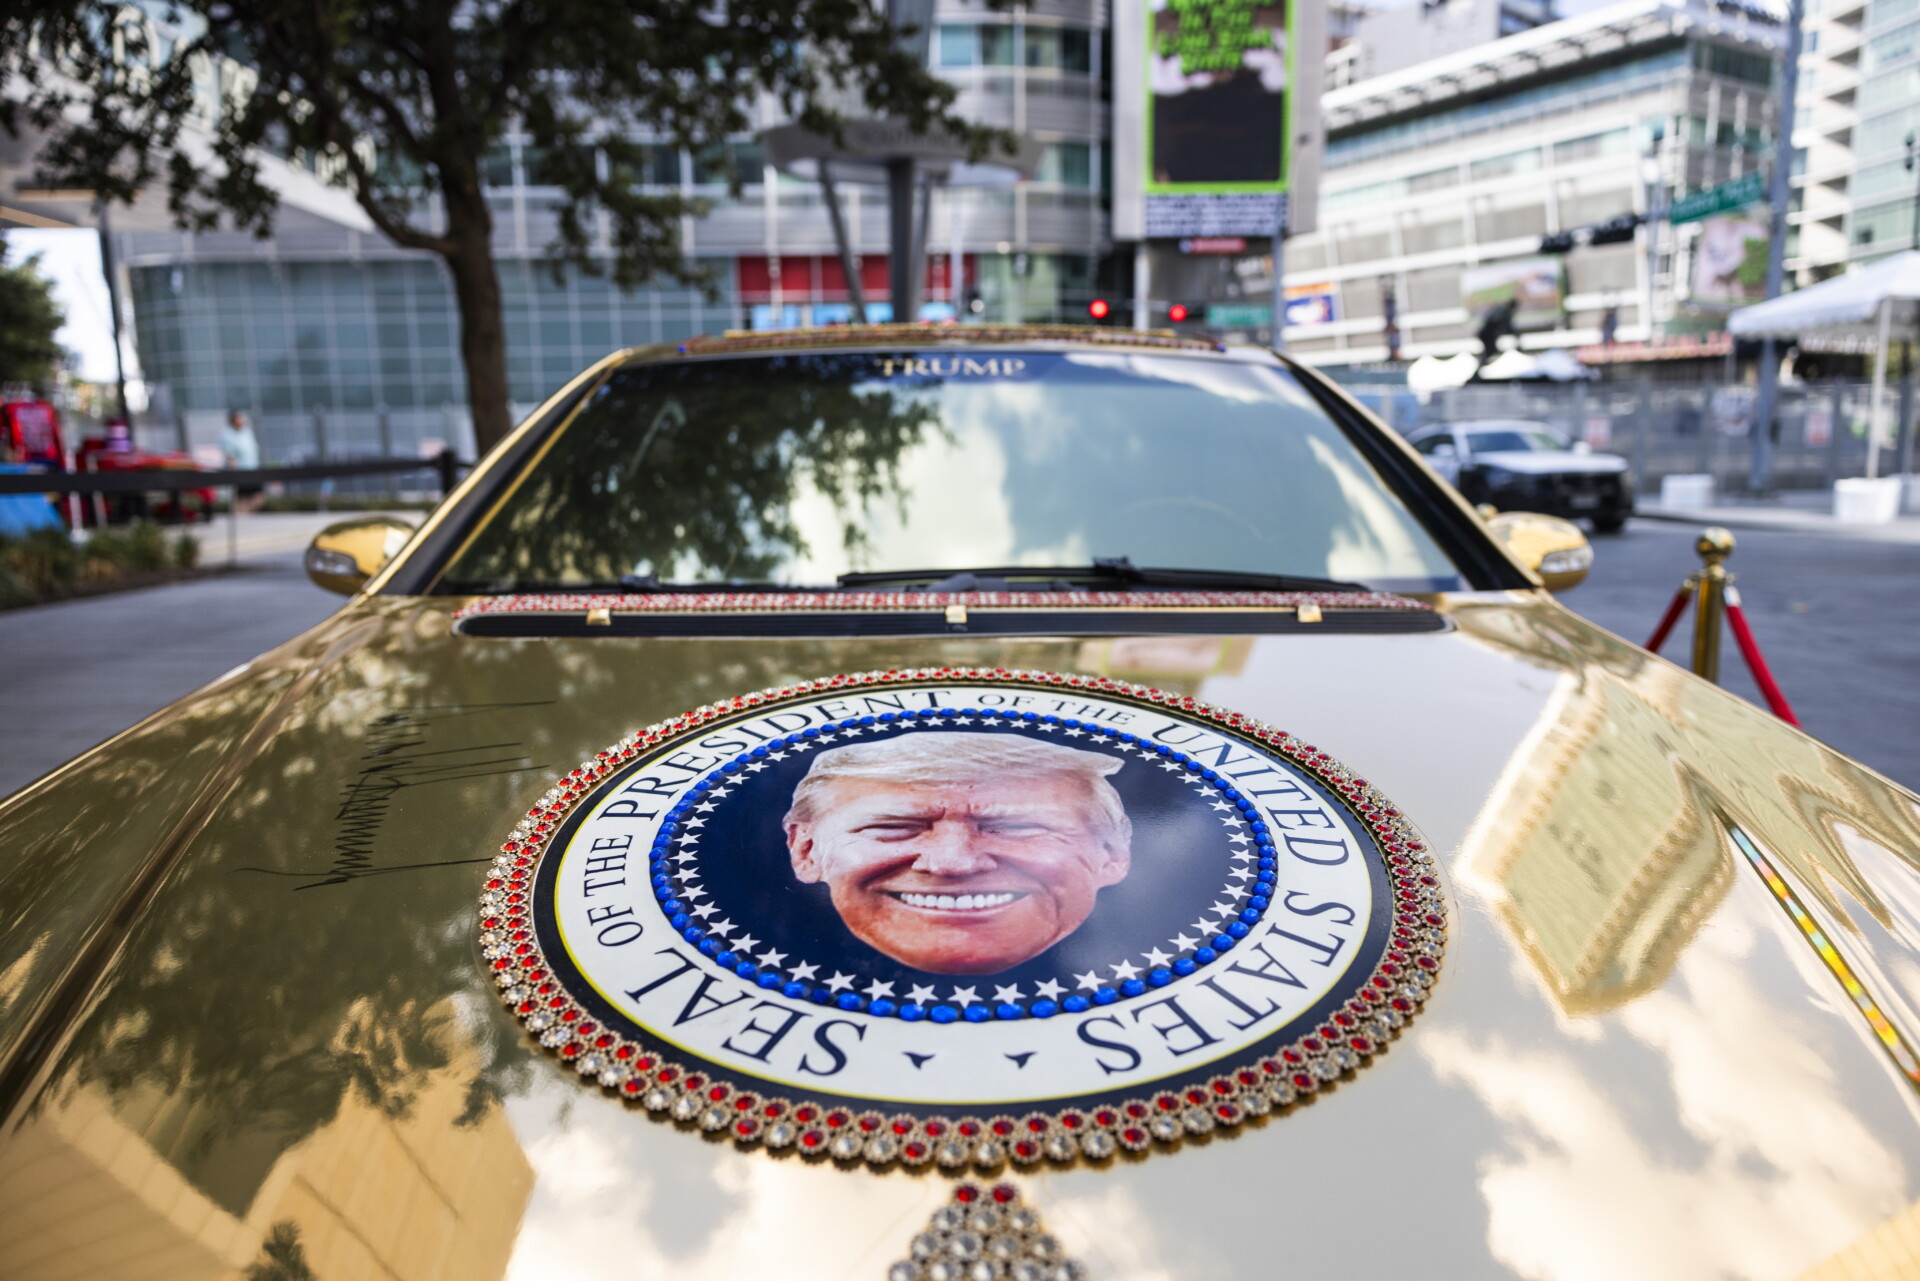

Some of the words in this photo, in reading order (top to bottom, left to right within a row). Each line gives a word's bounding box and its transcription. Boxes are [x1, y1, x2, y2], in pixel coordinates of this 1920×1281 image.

[873, 357, 1026, 377] TRUMP
[977, 693, 1036, 708] OF
[1050, 698, 1137, 726] THE
[596, 690, 951, 822] PRESIDENT
[1151, 722, 1350, 867] UNITED
[583, 834, 634, 898] THE
[586, 903, 644, 947] OF
[623, 946, 868, 1077] SEAL
[1076, 889, 1357, 1076] STATES
